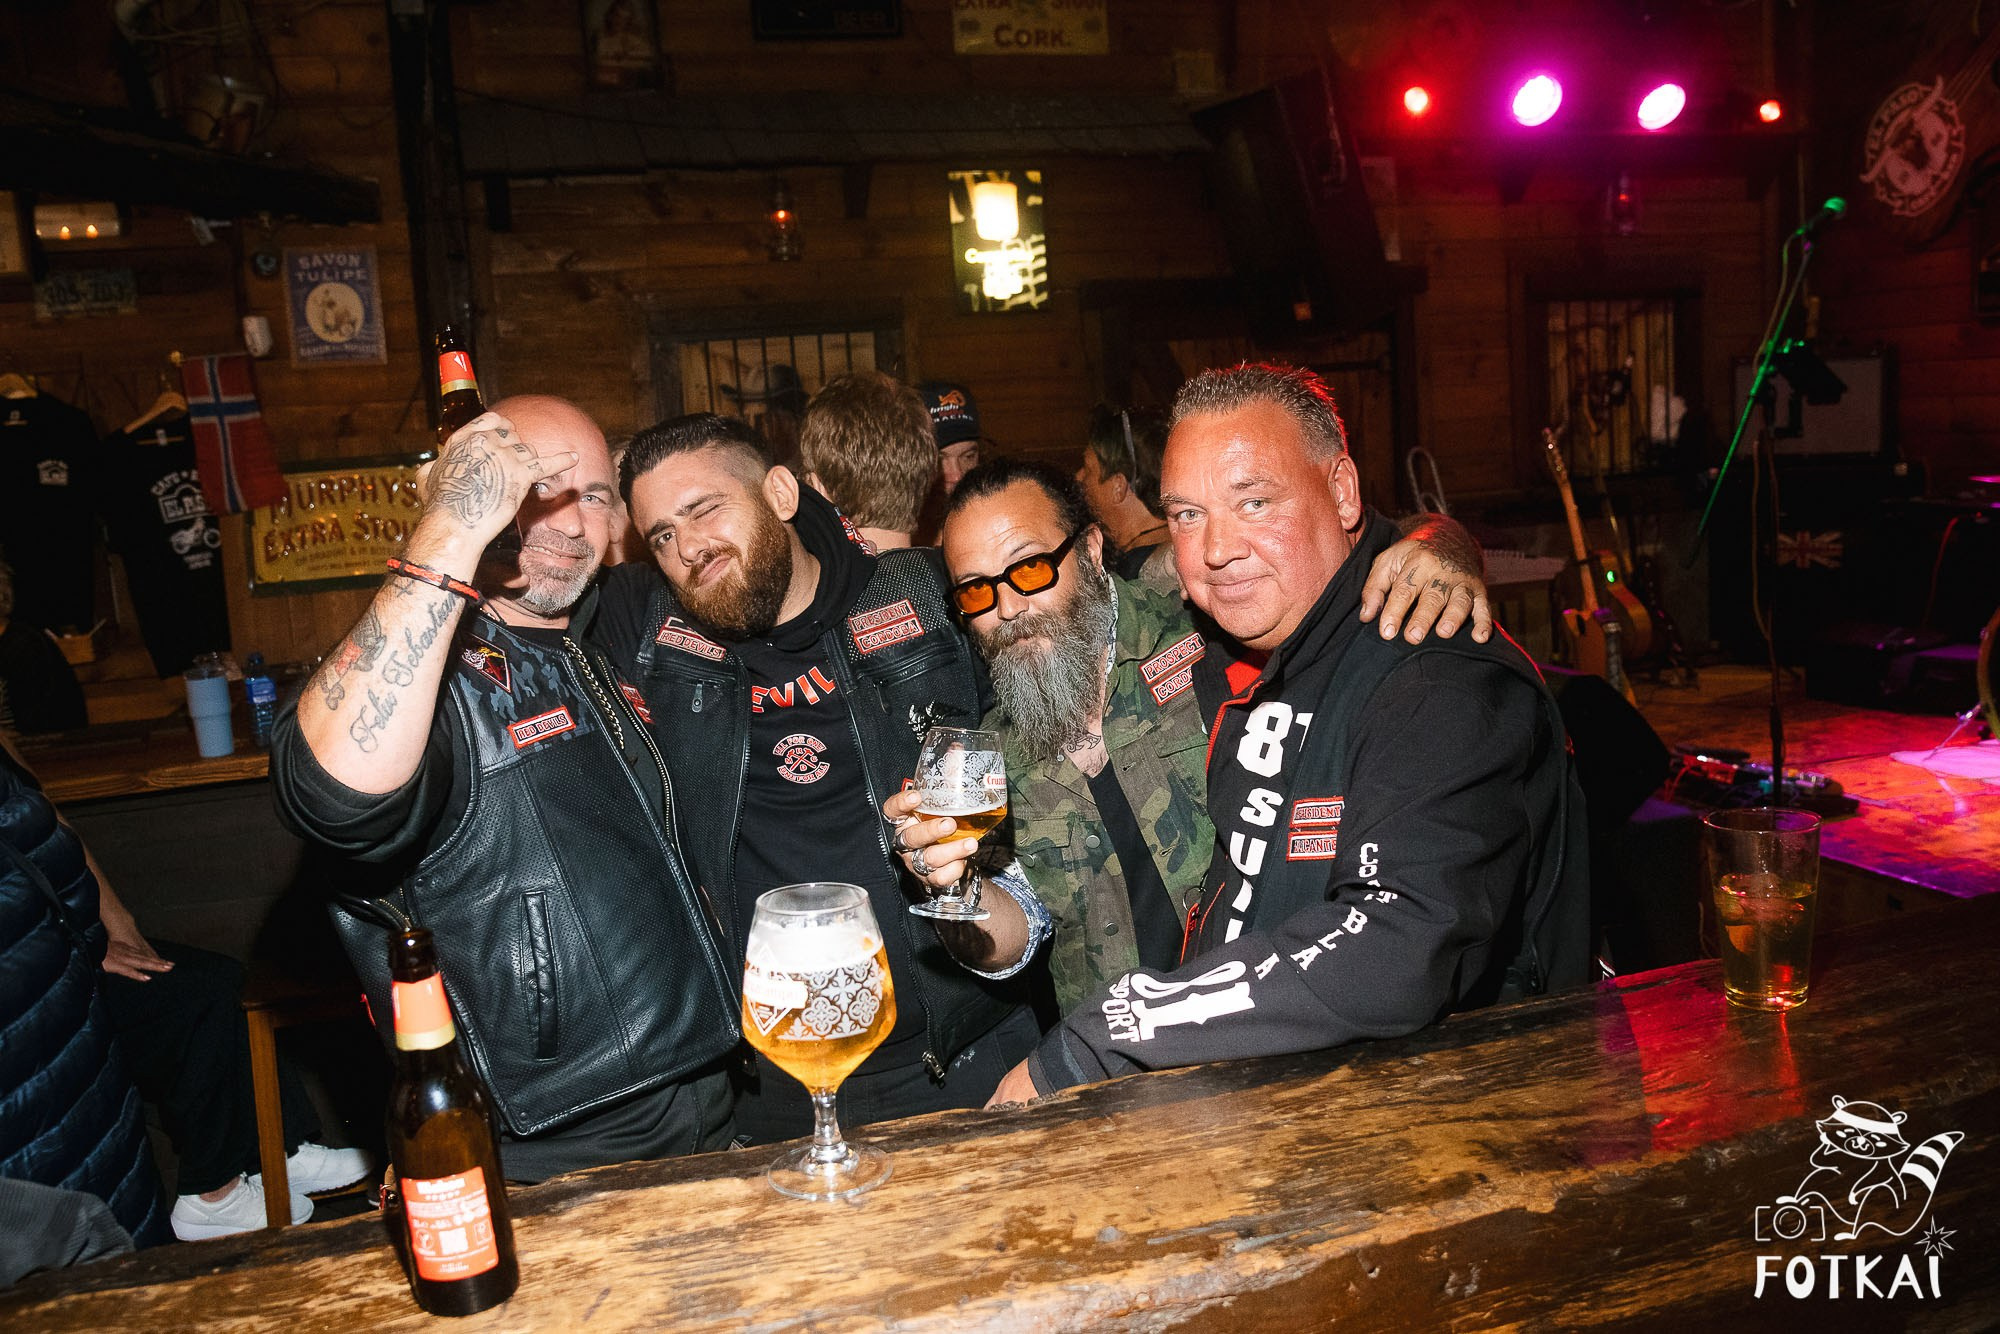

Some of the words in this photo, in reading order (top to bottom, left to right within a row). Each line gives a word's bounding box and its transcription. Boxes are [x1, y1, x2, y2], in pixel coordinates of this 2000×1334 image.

[298, 253, 361, 269] SAVON
[295, 269, 368, 282] TULIPE
[264, 518, 345, 563] EXTRA
[853, 603, 907, 630] PRESIDENT
[661, 631, 683, 646] RED
[683, 636, 721, 657] DEVILS
[862, 621, 919, 648] CORDOBA
[1145, 636, 1202, 678] PROSPECT
[516, 724, 537, 740] RED
[536, 714, 568, 733] DEVILS
[787, 736, 805, 746] FOR
